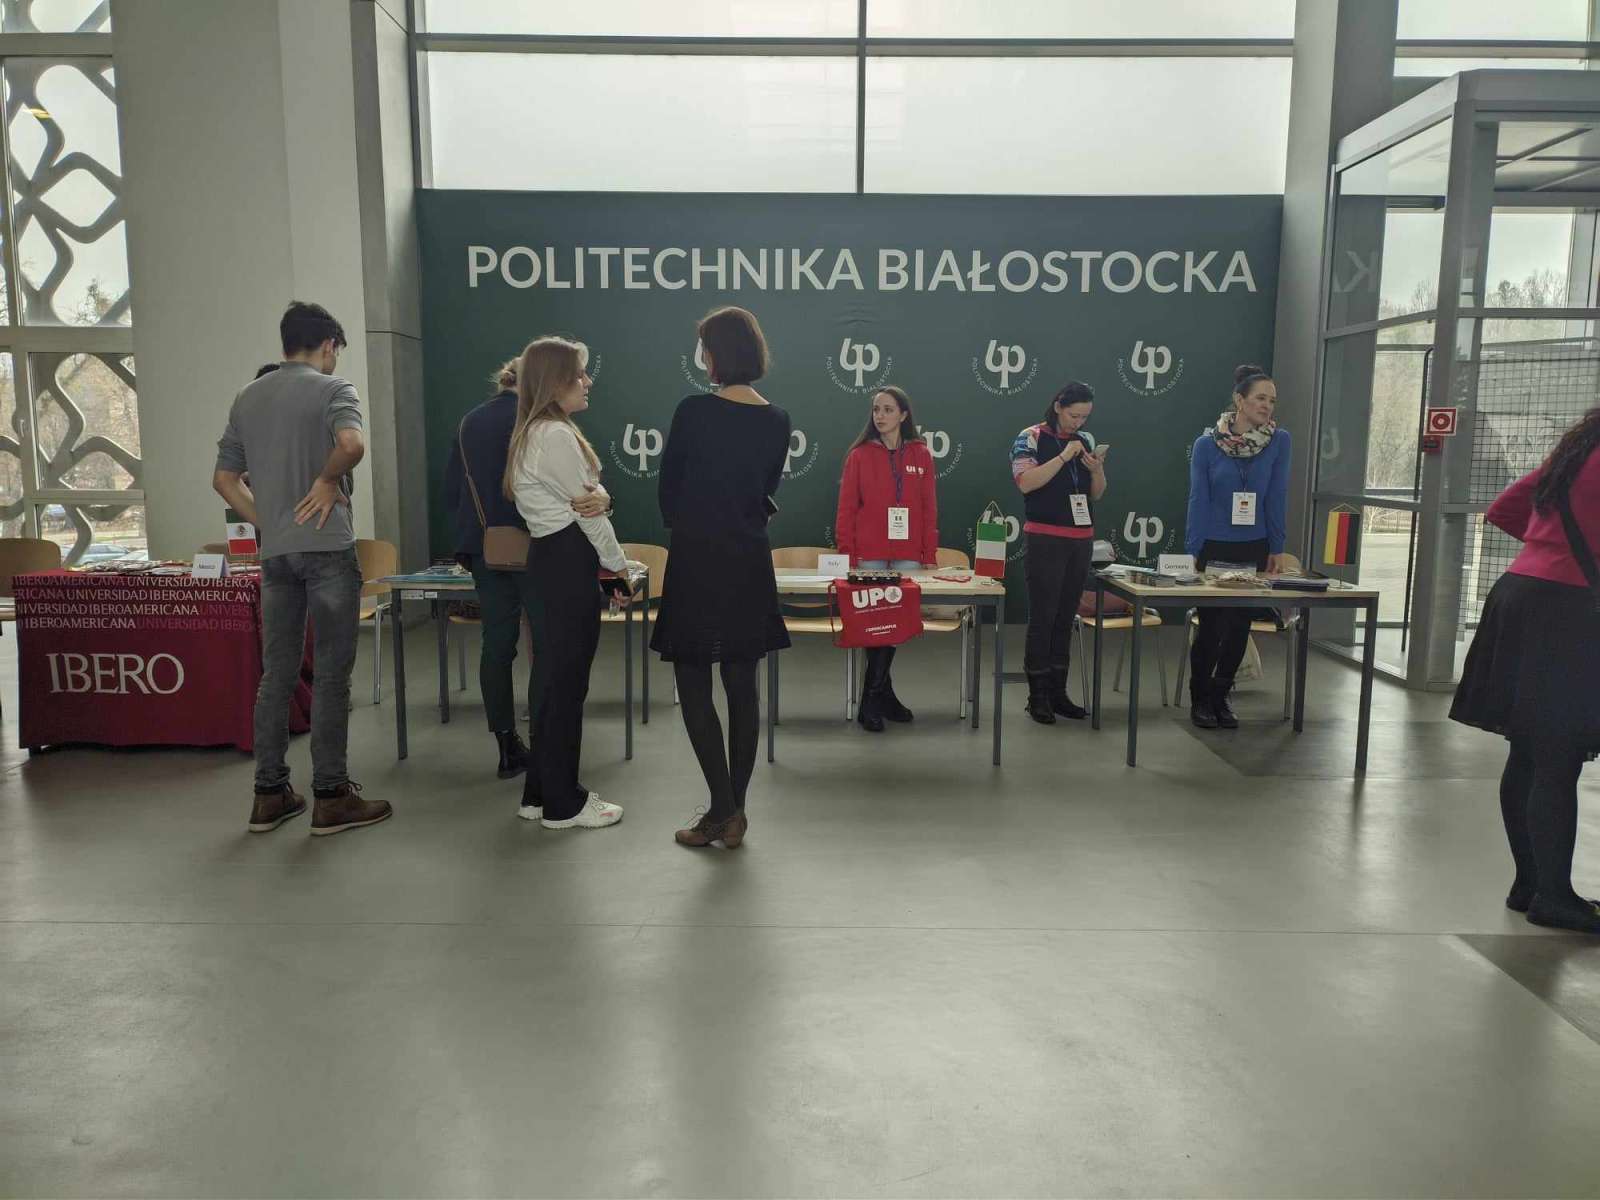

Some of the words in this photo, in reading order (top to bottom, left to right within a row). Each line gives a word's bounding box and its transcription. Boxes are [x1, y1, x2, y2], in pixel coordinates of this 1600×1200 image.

[467, 246, 865, 290] POLITECHNIKA
[878, 247, 1256, 294] BIAŁOSTOCKA
[127, 576, 209, 587] UNIVERSIDAD
[66, 588, 147, 600] UNIVERSIDAD
[850, 585, 903, 609] UPO
[89, 603, 200, 616] IBEROAMERICANA
[24, 617, 137, 630] IBEROAMERICANA
[46, 652, 186, 695] IBERO
